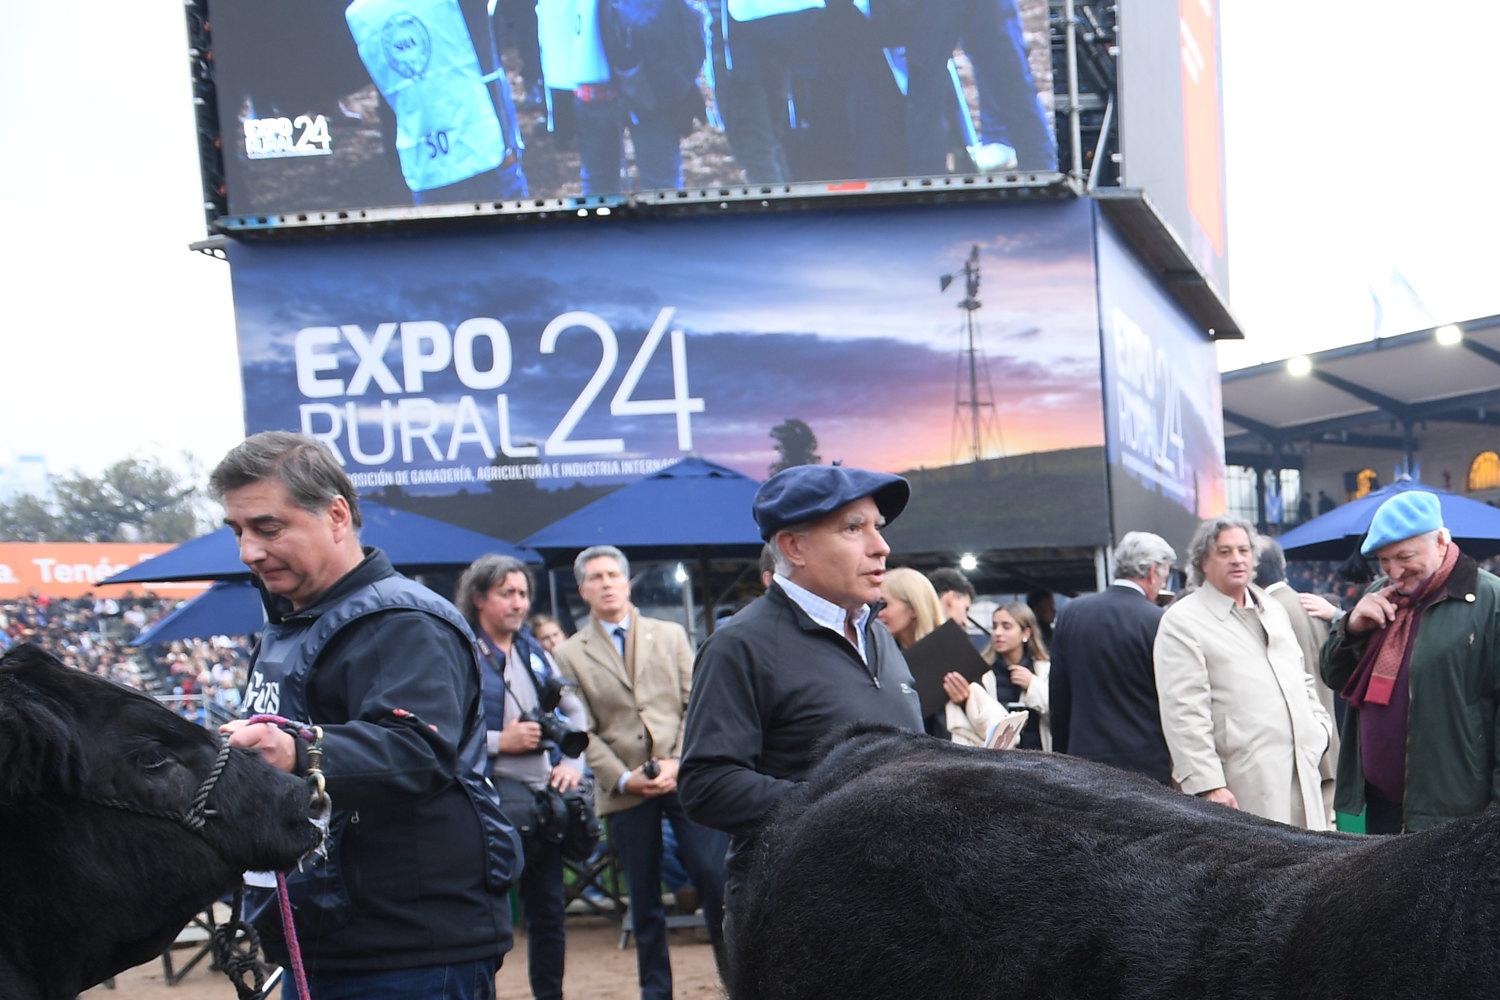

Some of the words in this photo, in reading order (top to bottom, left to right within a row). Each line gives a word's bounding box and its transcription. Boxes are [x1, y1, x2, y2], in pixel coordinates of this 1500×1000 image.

[293, 114, 332, 152] 24
[295, 317, 513, 398] EXPO
[539, 306, 705, 456] 24
[299, 393, 539, 467] RURAL
[345, 468, 393, 488] OSICIÓN
[394, 470, 410, 486] DE
[410, 464, 475, 485] GANADERÍA,
[476, 463, 550, 483] AGRICULTURA
[552, 464, 560, 479] E
[561, 461, 619, 478] INDUSTRIA
